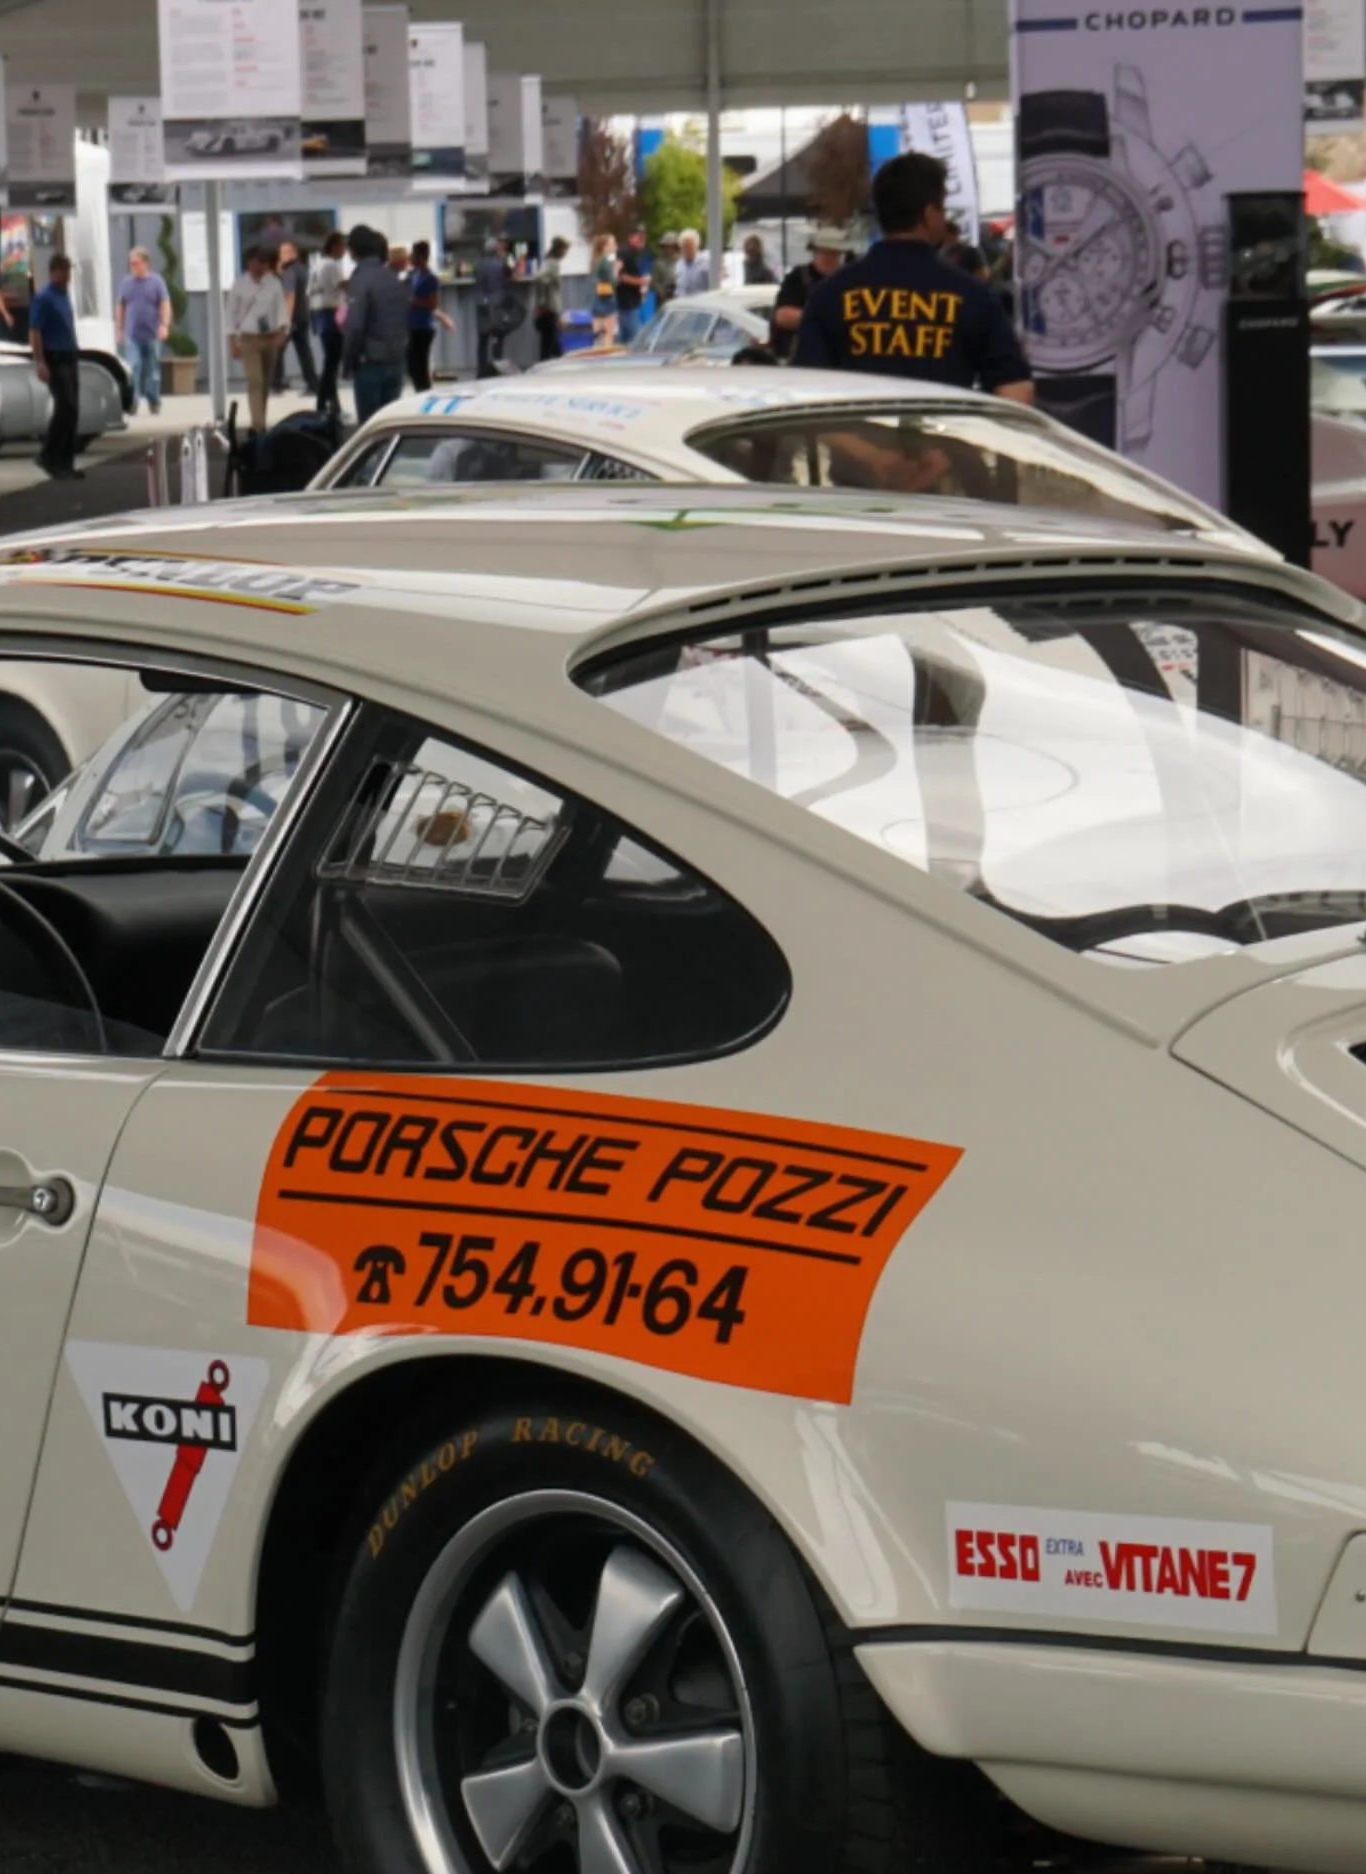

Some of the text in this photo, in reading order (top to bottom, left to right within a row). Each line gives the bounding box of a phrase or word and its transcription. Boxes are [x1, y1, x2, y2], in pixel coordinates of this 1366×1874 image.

[1085, 8, 1235, 31] CHOPARD
[842, 287, 962, 323] EVENT
[849, 322, 954, 359] STAFF
[283, 1106, 909, 1237] PORSCHE POZZI
[109, 1401, 233, 1444] KONI
[367, 1417, 655, 1557] DUNLOP RACING
[955, 1528, 1040, 1582] ESSO
[1045, 1538, 1084, 1557] EXTRA
[1065, 1569, 1103, 1588] AVEC
